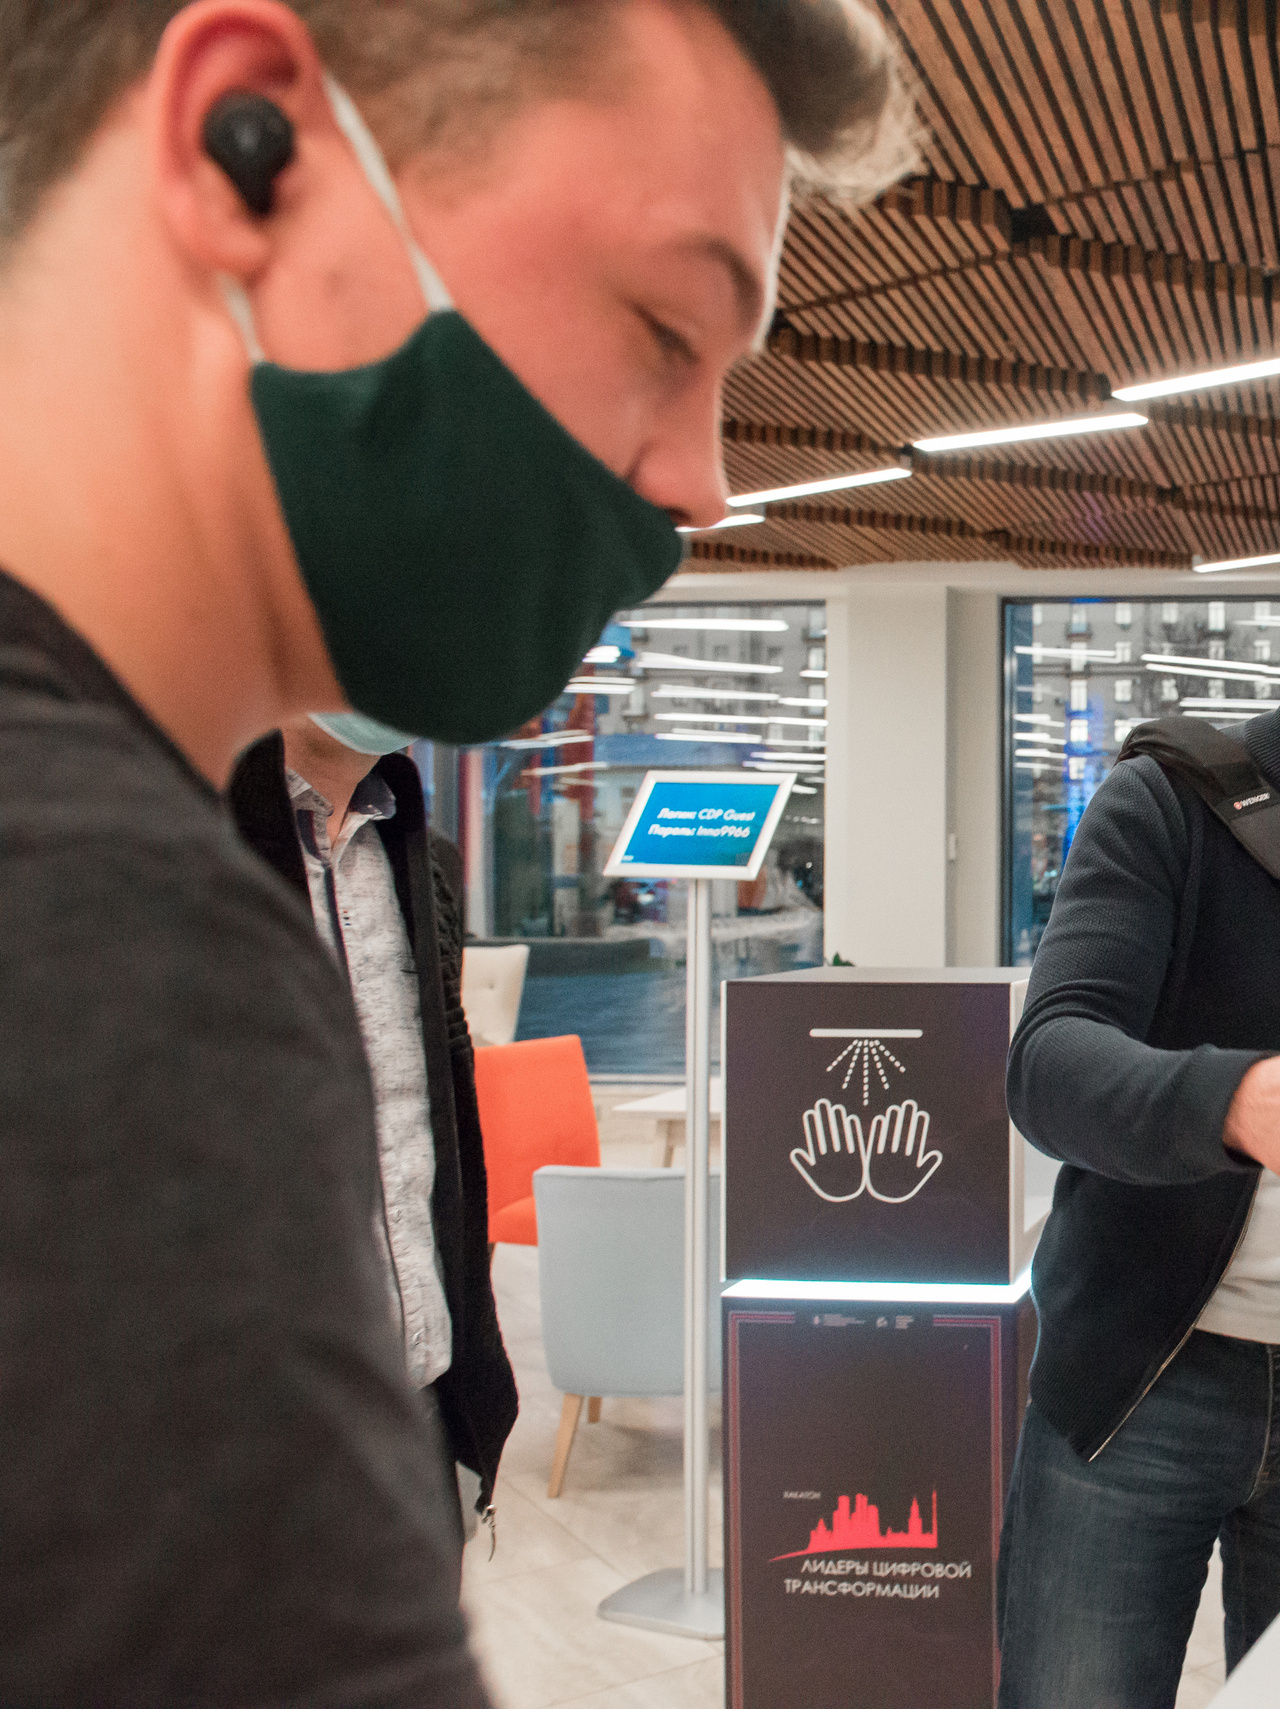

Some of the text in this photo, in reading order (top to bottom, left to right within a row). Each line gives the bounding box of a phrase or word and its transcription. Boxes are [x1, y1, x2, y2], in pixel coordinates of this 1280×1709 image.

[698, 808, 723, 820] CDP
[723, 809, 756, 821] Guest
[801, 1559, 972, 1579] ЛИДЕРЫ ЦИФРОВОЙ
[784, 1578, 940, 1600] ТРАНСФОРМАЦИИ
